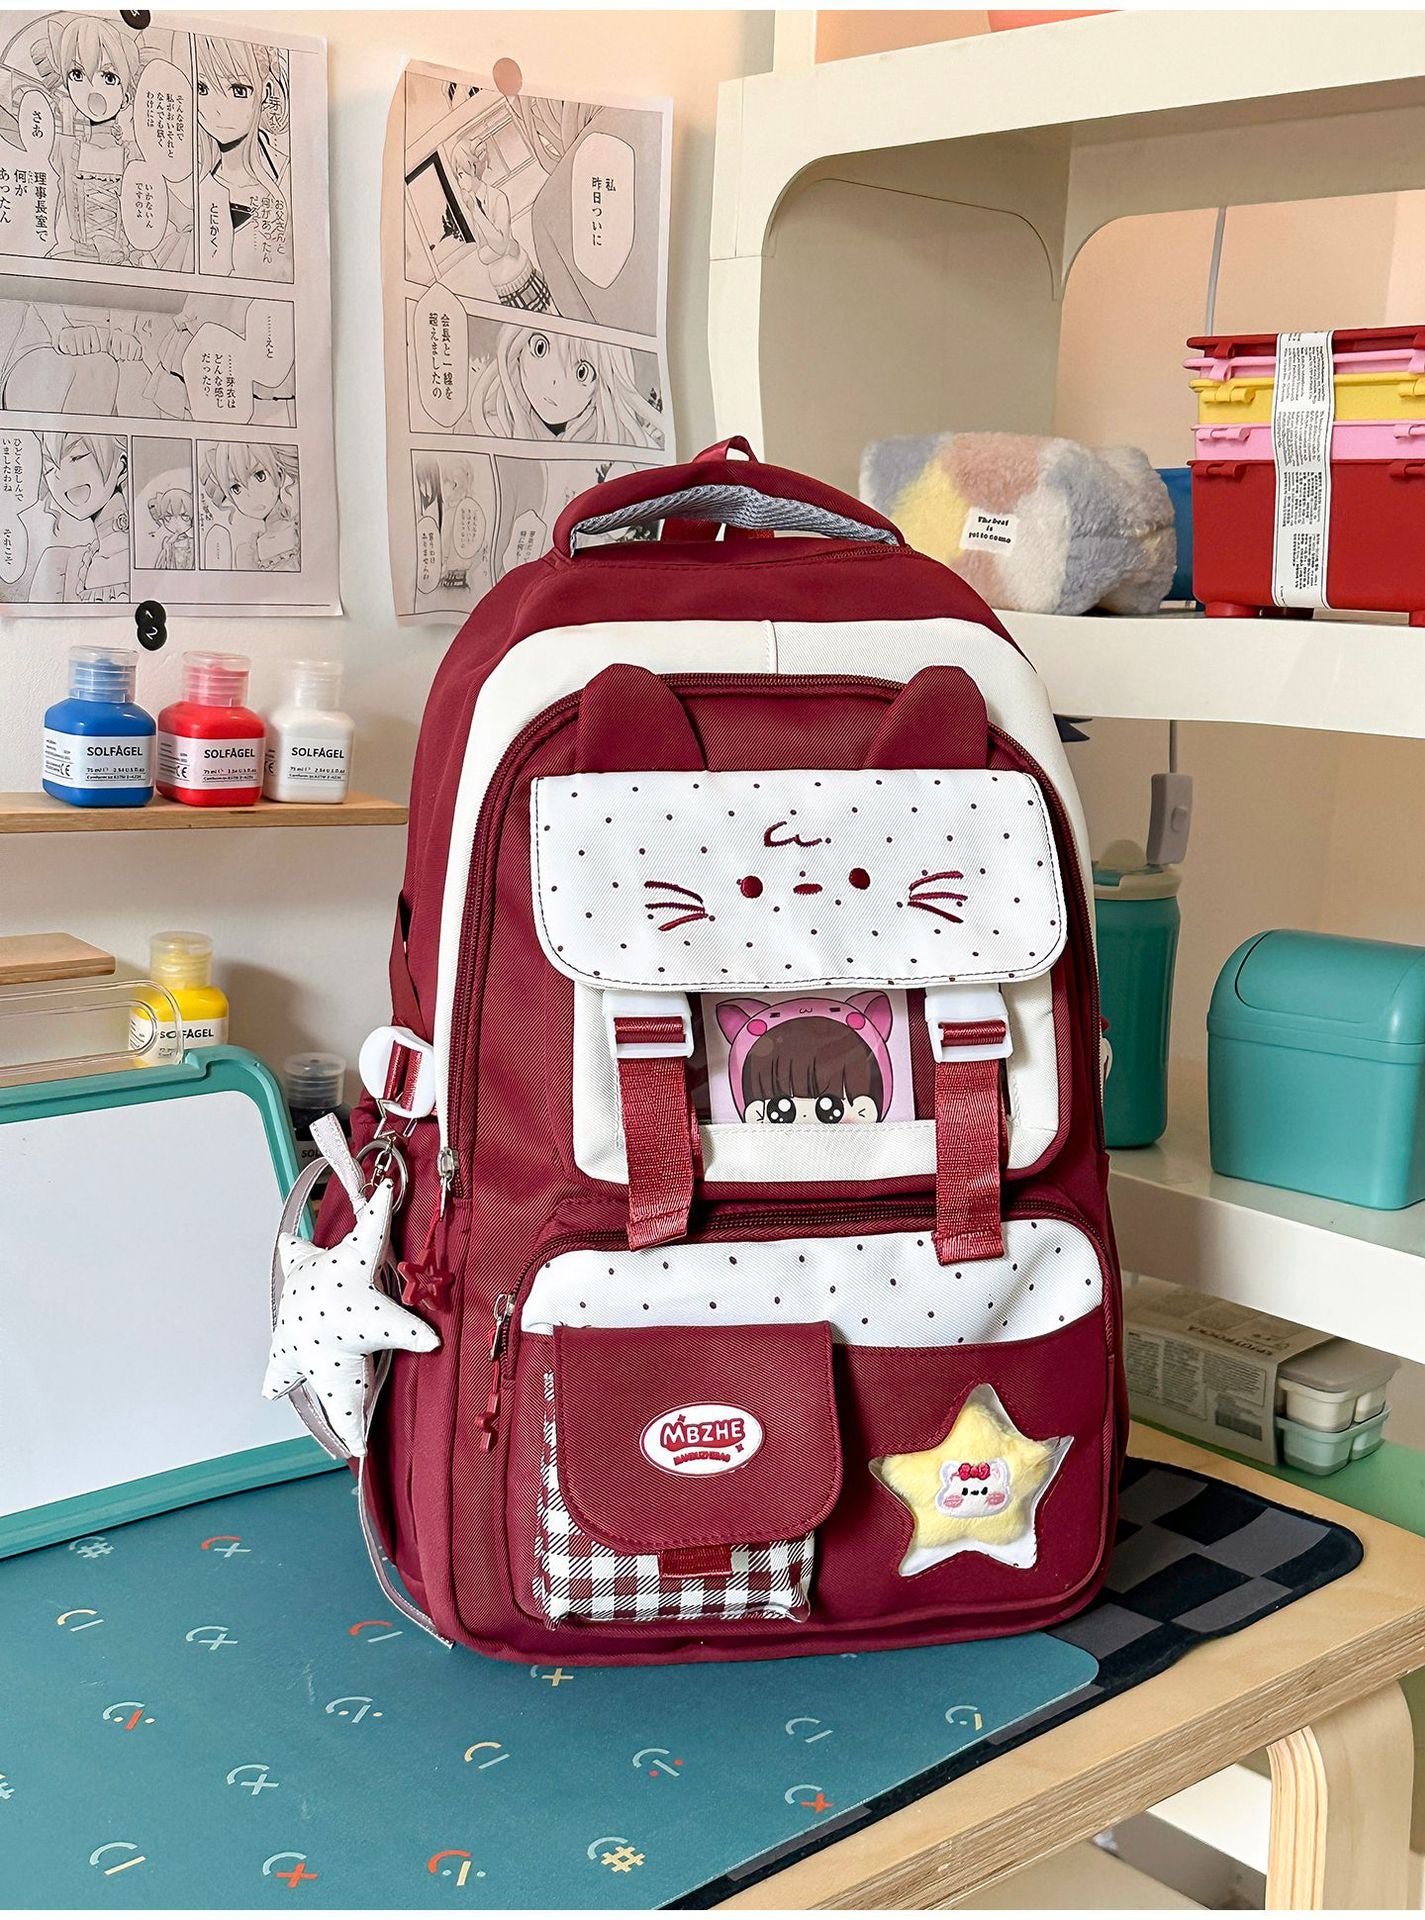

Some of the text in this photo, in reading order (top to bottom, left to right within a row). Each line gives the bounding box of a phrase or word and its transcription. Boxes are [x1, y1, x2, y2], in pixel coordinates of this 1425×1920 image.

[32, 110, 44, 138] さあ
[14, 168, 28, 196] 何が
[605, 177, 616, 191] 私
[34, 171, 48, 242] 理事長室で
[592, 176, 602, 246] 昨日ついに
[429, 312, 442, 399] 超えましたの
[441, 313, 453, 400] 会長と一線を
[214, 353, 223, 408] どんな感じ
[87, 745, 143, 756] SOLFÅGEL
[203, 747, 255, 759] SOLFÅGEL
[291, 747, 345, 759] SOLFÅGEL
[662, 1419, 744, 1448] MBZHE
